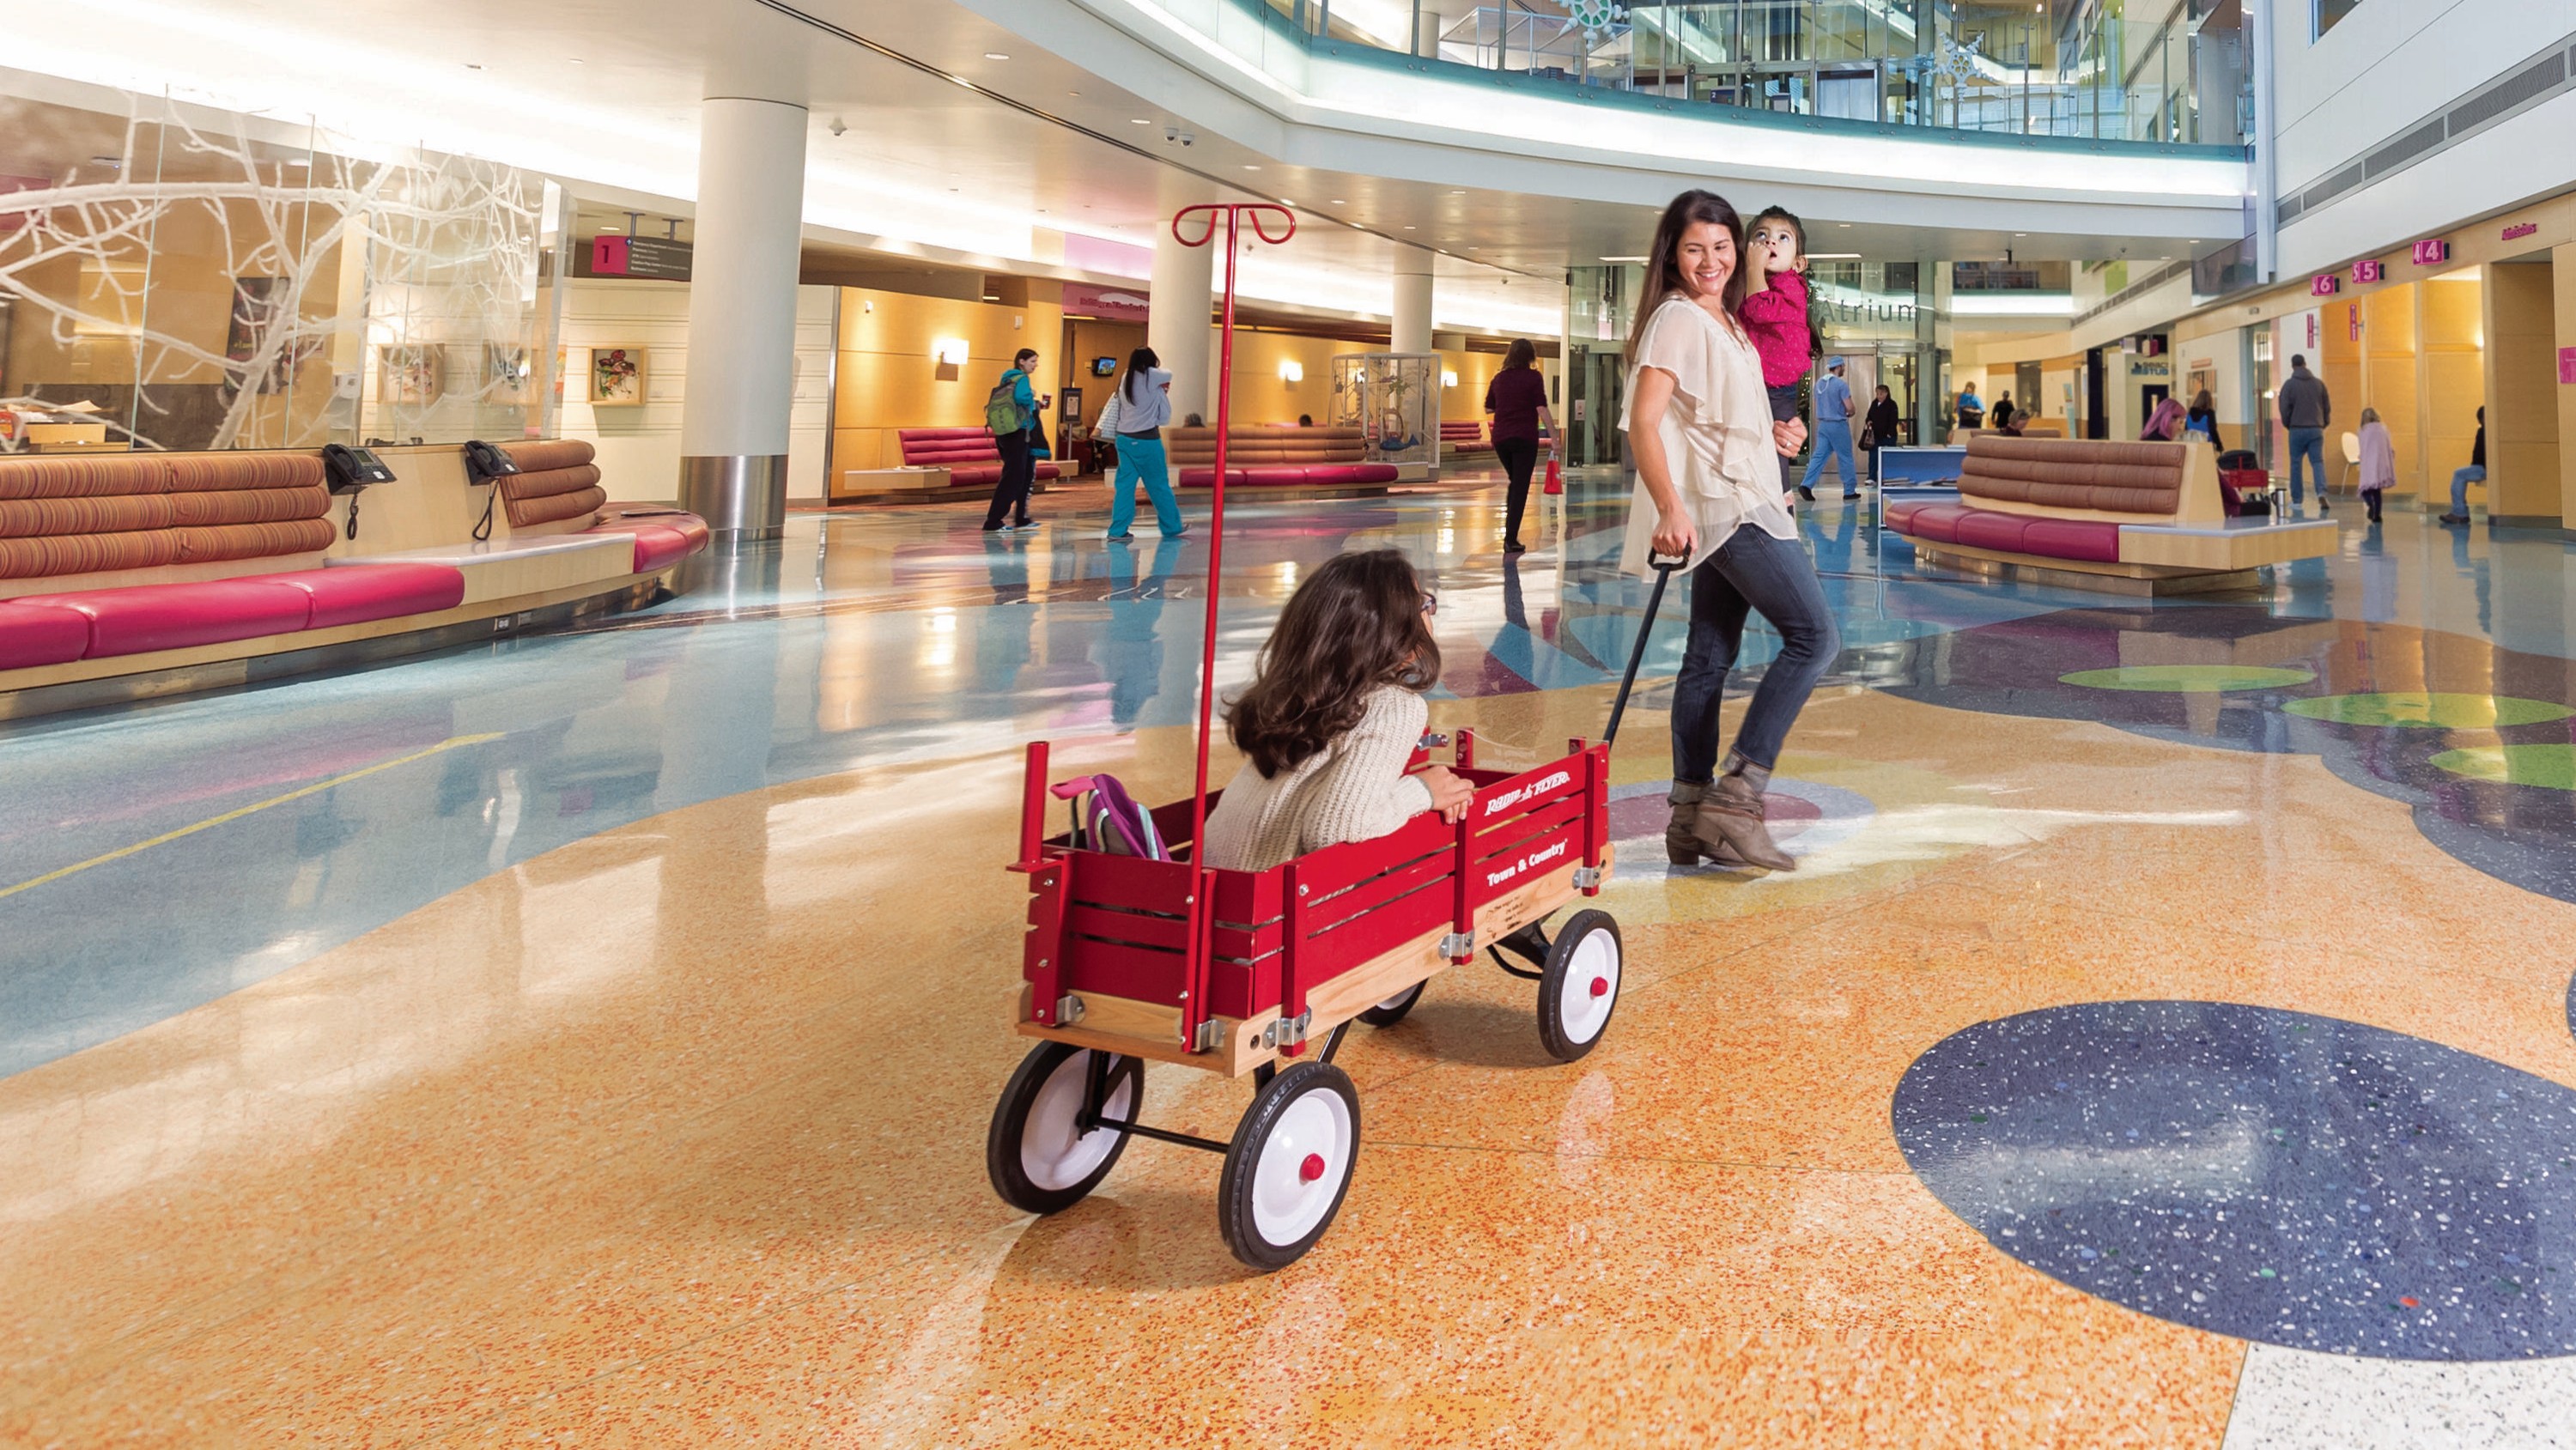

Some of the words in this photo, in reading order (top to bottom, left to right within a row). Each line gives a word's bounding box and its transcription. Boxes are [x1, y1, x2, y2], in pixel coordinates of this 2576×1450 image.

[602, 245, 610, 264] 1
[2425, 241, 2439, 260] 4
[2363, 262, 2375, 280] 5
[2320, 276, 2331, 293] 6
[1817, 299, 1921, 323] Atrium
[1531, 771, 1571, 796] FLYER
[1487, 865, 1516, 887] Town
[1517, 858, 1527, 872] &
